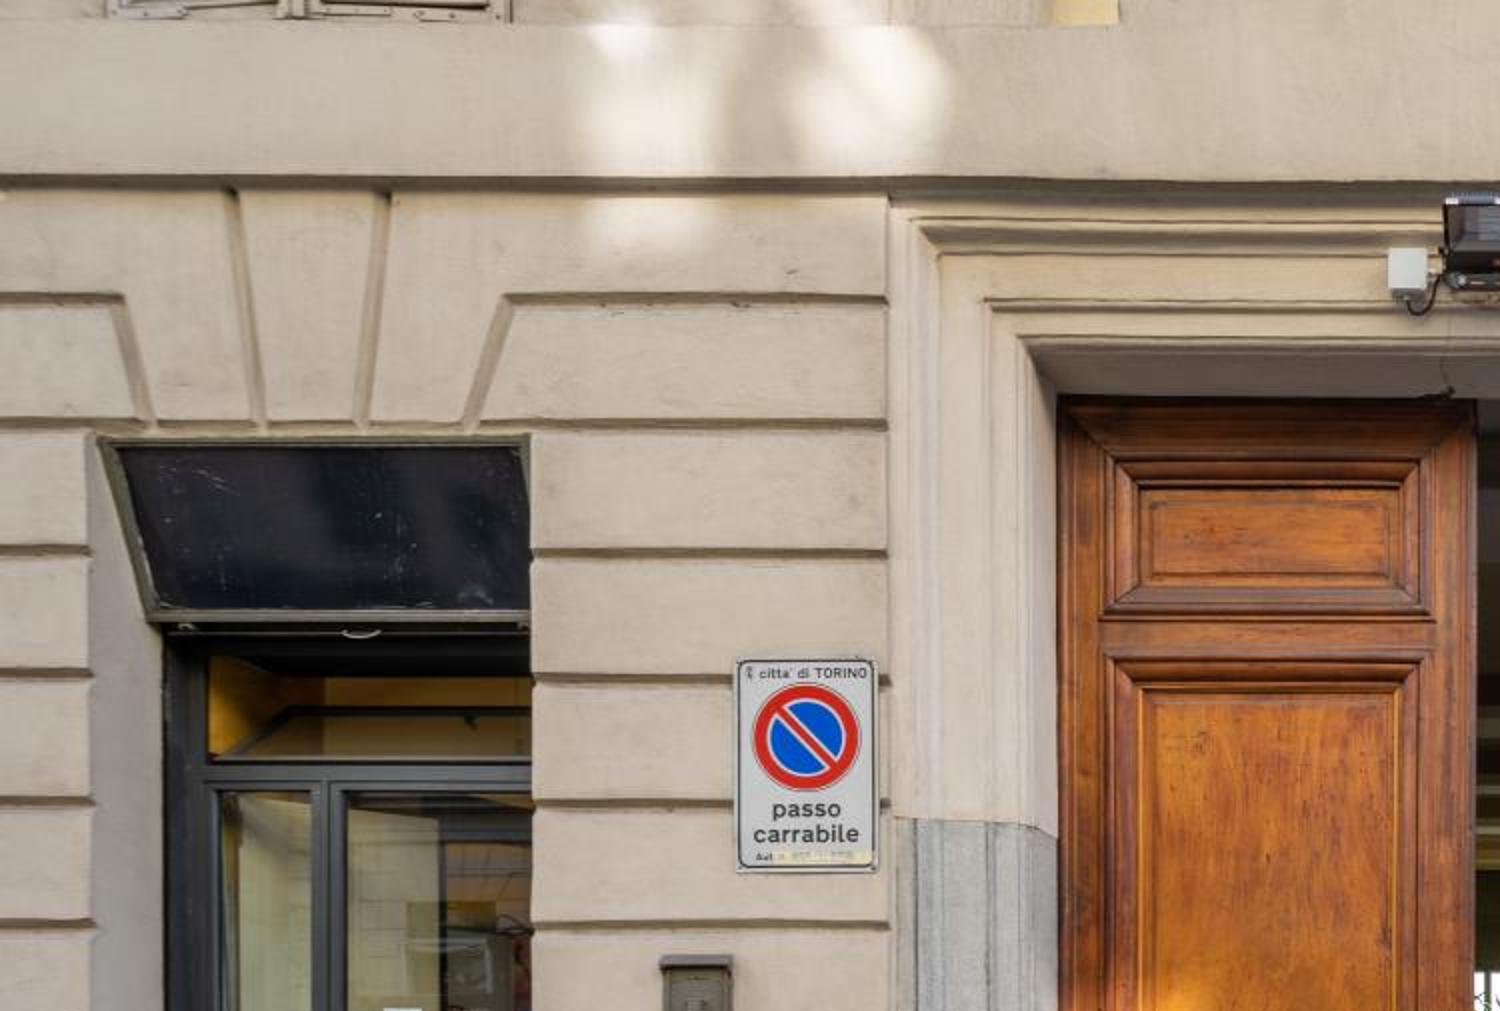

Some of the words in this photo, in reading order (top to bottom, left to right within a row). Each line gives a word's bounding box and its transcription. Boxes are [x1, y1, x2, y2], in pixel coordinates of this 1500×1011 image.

[798, 667, 810, 679] di
[814, 667, 868, 679] TORINO
[772, 803, 841, 821] passo
[753, 824, 859, 843] carrabile
